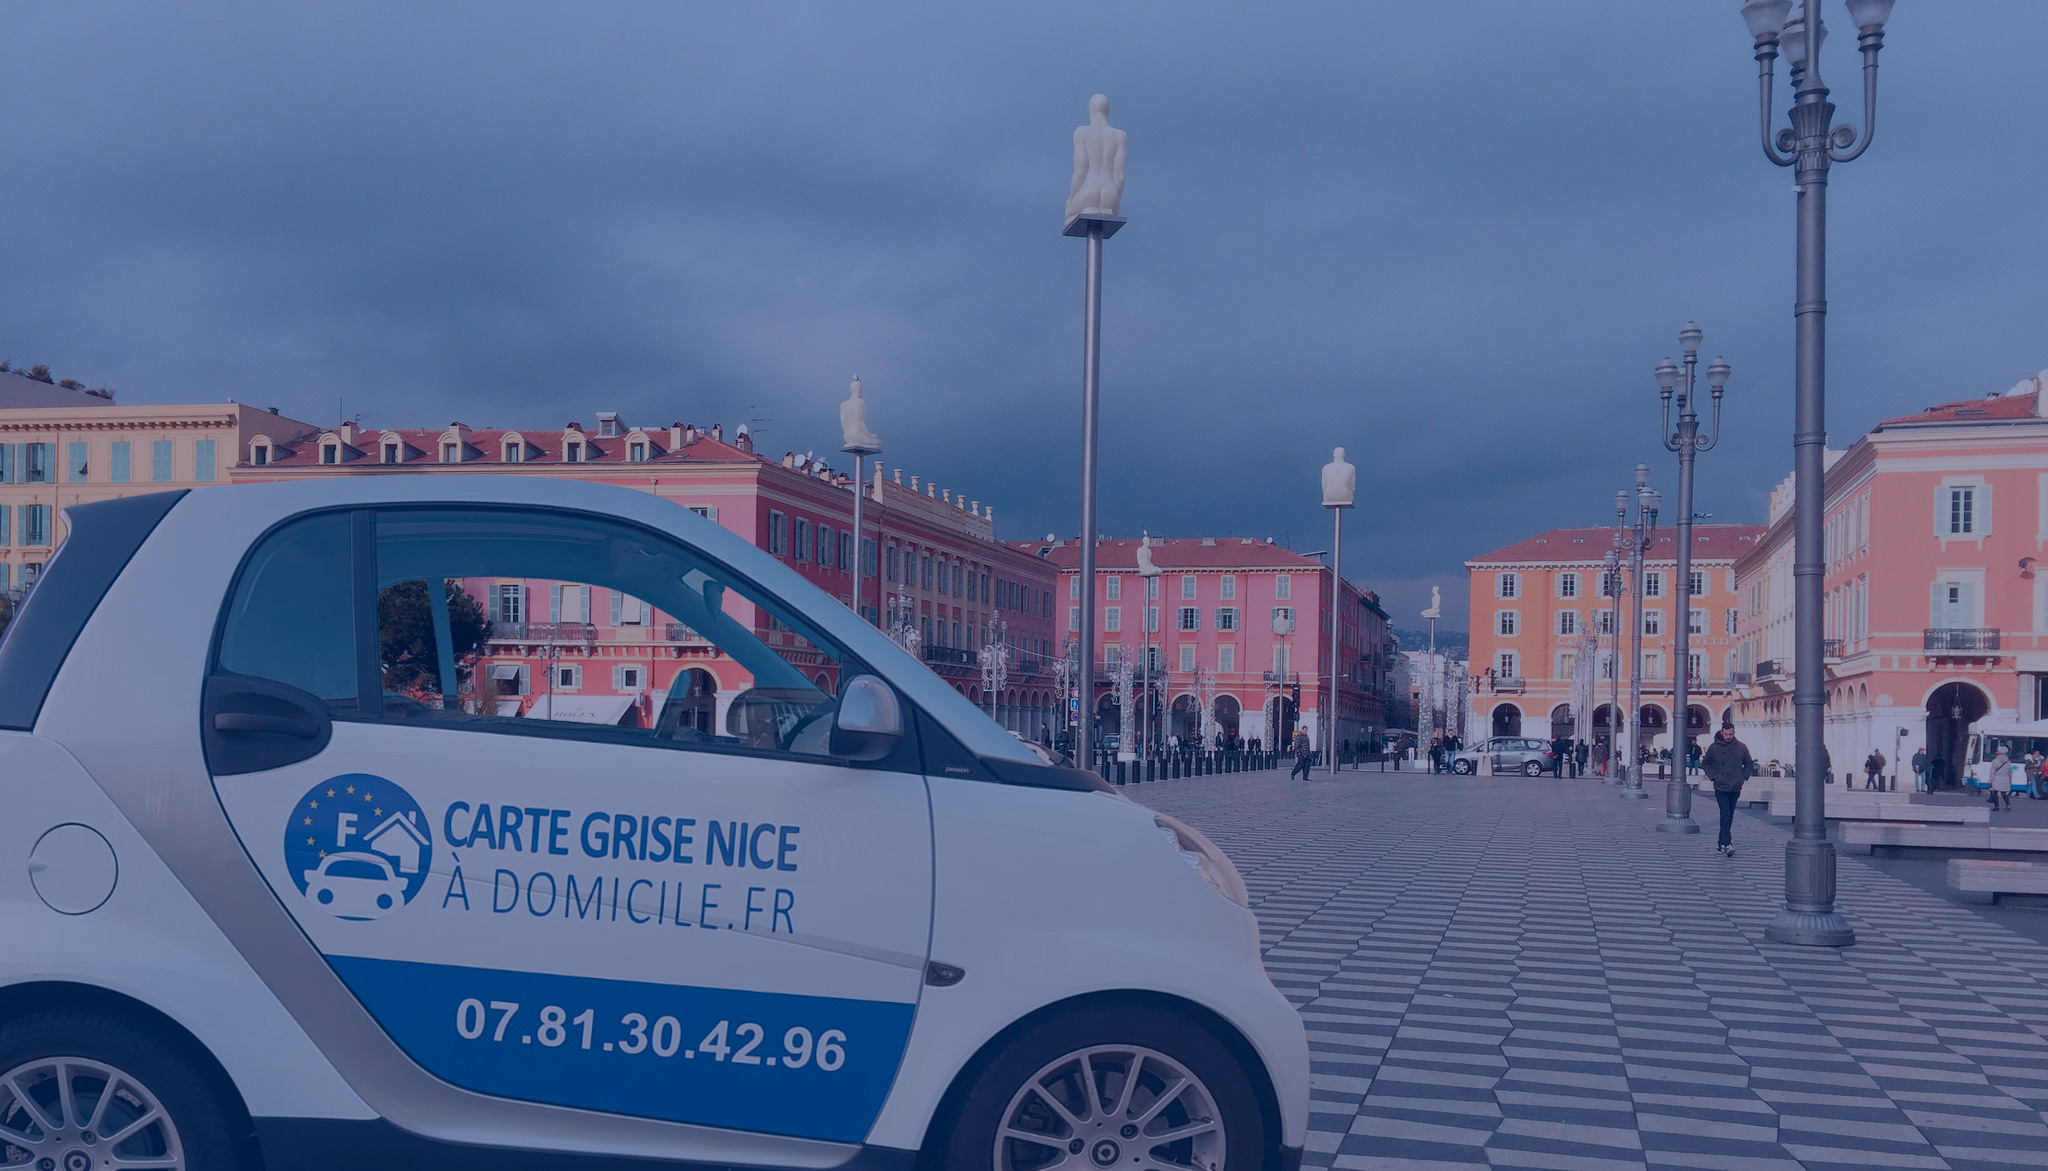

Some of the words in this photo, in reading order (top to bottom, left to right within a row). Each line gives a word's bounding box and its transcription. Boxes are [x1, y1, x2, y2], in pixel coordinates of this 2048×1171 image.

[1659, 637, 1732, 647] LAAYETTE
[336, 812, 359, 848] F
[443, 800, 572, 856] CARTE
[580, 811, 697, 864] GRISE
[705, 820, 801, 872] NICE
[442, 851, 471, 912] À
[492, 868, 795, 935] DOMICILE.FR
[456, 997, 847, 1072] 07.81.30.42.96
